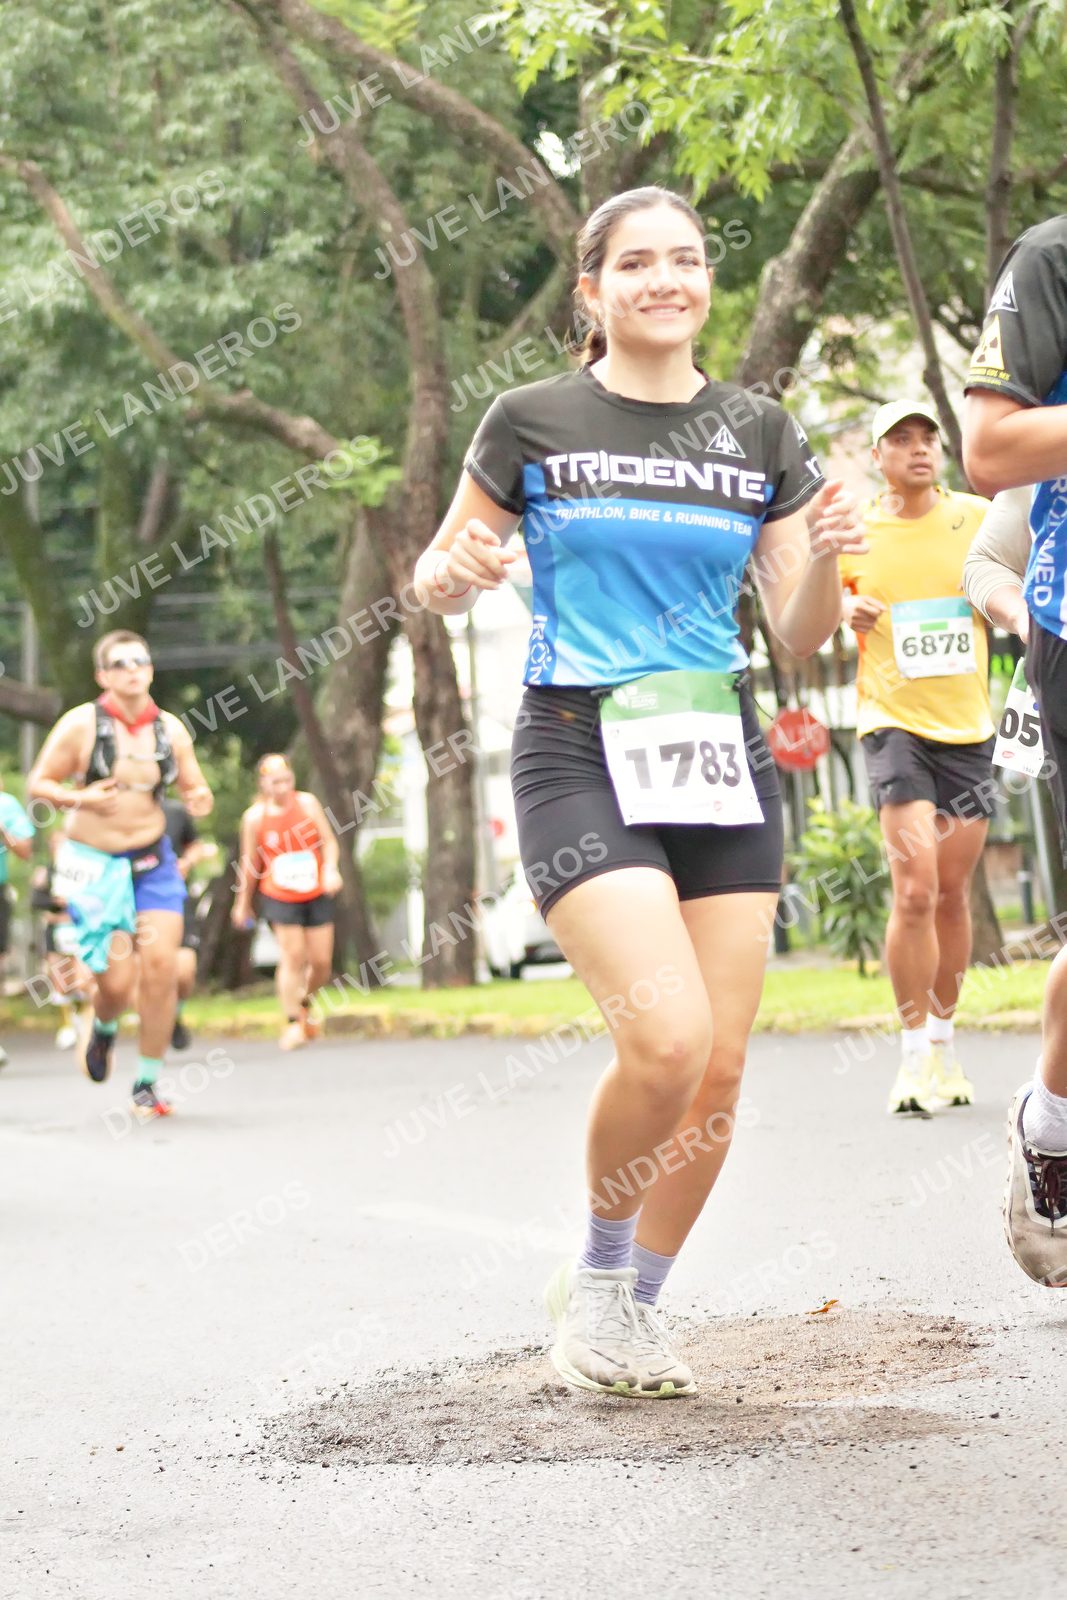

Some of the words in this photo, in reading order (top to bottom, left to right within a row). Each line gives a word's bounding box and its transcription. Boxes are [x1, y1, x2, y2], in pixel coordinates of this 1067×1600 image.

[545, 450, 766, 502] TRIDENTE
[555, 506, 626, 521] TRIATHLON,
[629, 507, 660, 522] BIKE
[663, 510, 673, 523] &
[675, 512, 731, 531] RUNNING
[902, 632, 970, 657] 6878
[624, 740, 742, 789] 1783
